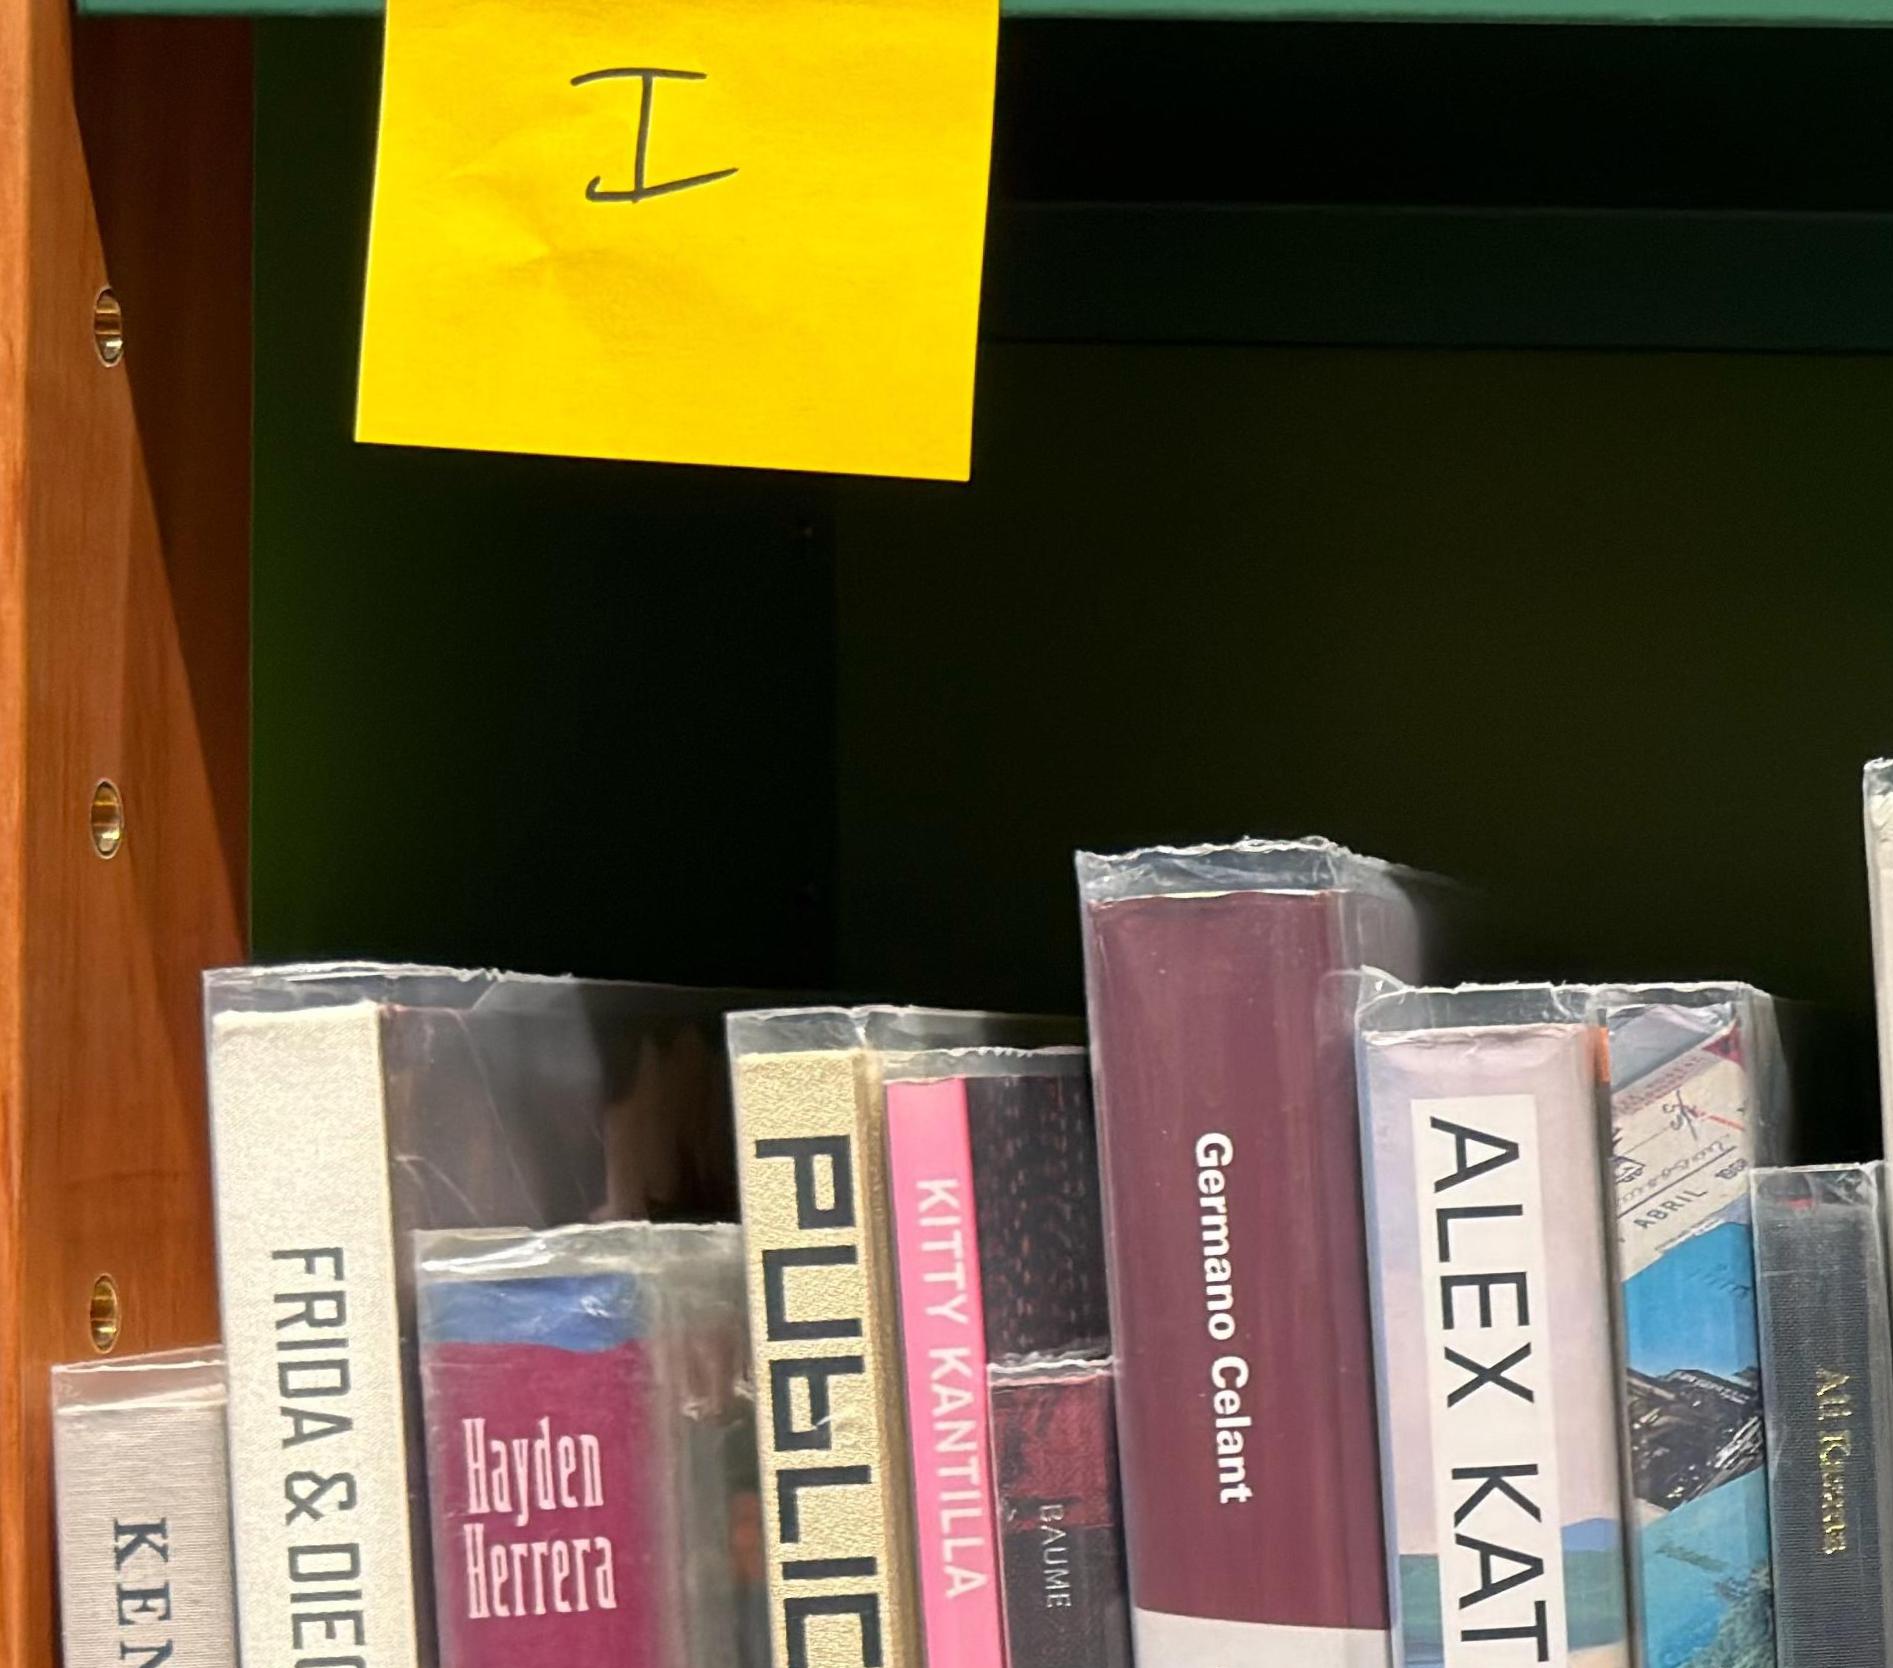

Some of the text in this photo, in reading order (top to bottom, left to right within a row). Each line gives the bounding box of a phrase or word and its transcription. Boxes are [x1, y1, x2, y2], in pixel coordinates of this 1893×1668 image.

[570, 67, 739, 204] I
[1195, 1131, 1254, 1505] Germano Celant
[1429, 1116, 1535, 1408] ALEX
[271, 1246, 353, 1450] FRIDA
[915, 1177, 989, 1600] KITTY KANTILLA
[284, 1469, 358, 1527] &
[462, 1416, 604, 1527] Hayden
[464, 1523, 617, 1619] Herrera
[1039, 1503, 1072, 1608] BAUME
